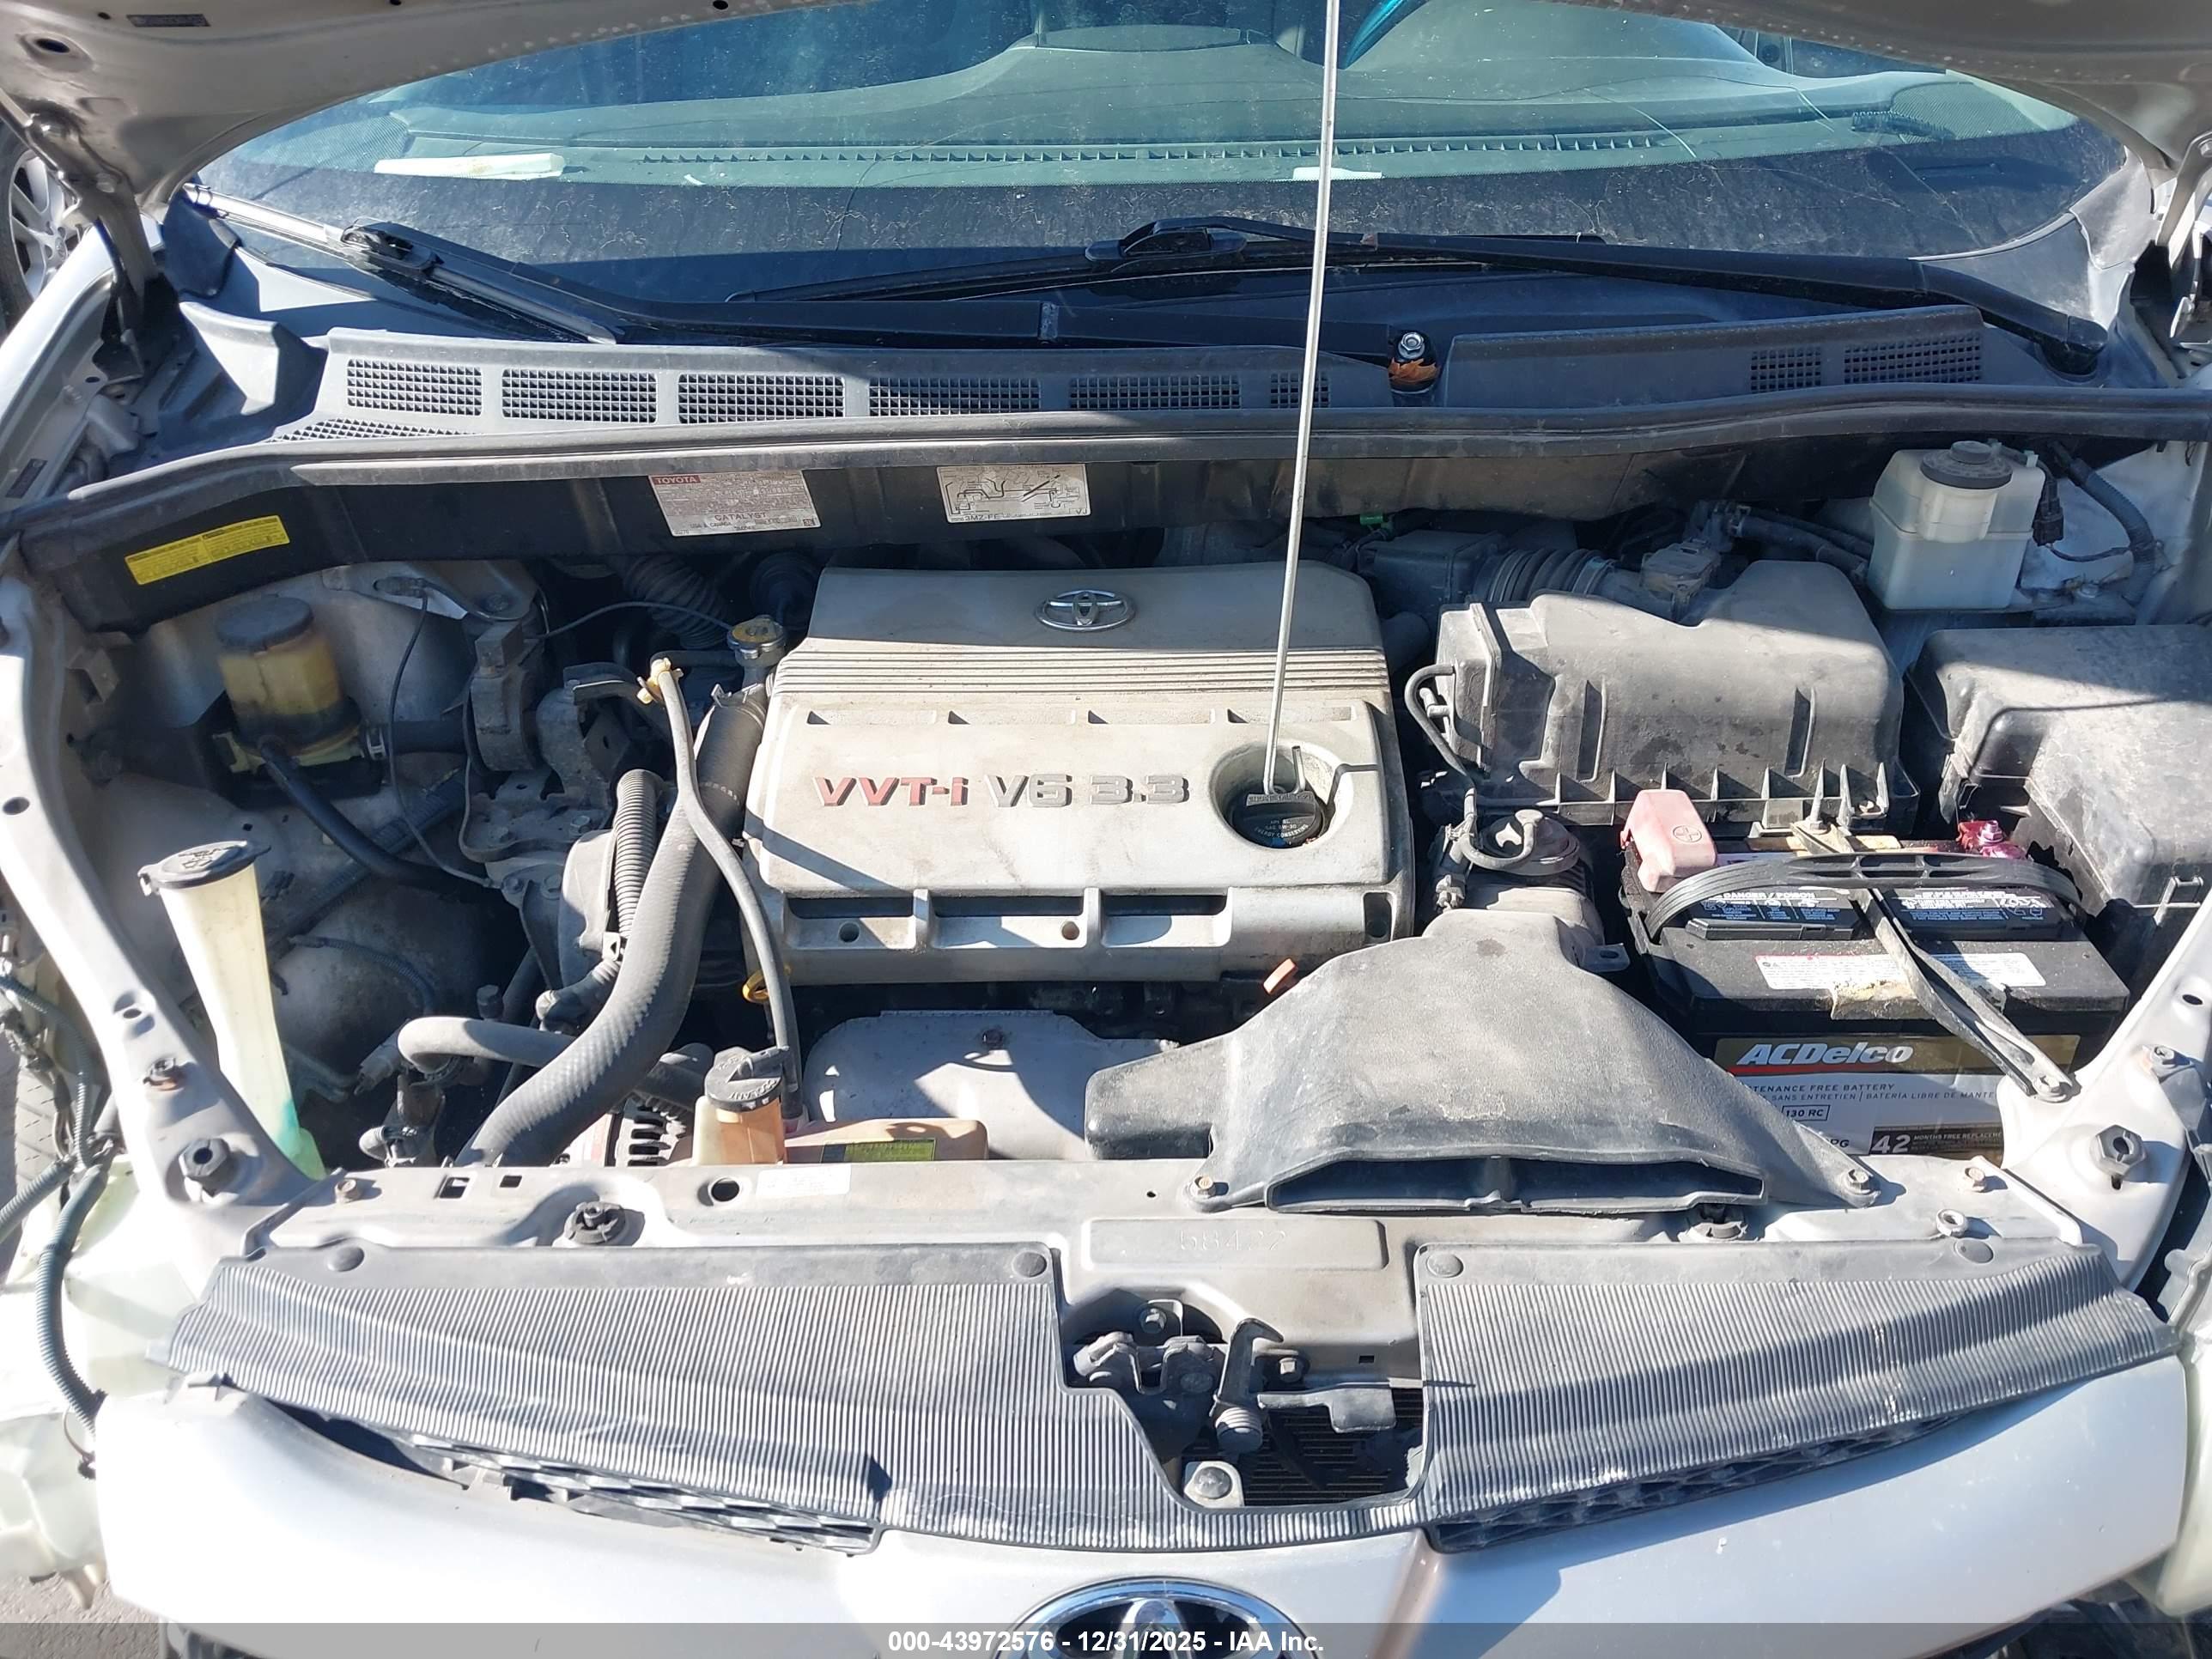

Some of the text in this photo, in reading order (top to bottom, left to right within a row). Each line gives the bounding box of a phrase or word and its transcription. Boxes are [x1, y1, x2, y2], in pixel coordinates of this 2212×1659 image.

[656, 476, 697, 484] TOYOTA
[714, 512, 767, 521] CATALYST
[812, 775, 1190, 807] VVT-i V6 3.3
[1735, 1042, 1914, 1065] ACDelco
[1866, 1091, 1908, 1100] BATERÍA
[1785, 1109, 1825, 1118] 130 RC
[1870, 1134, 1911, 1154] 42
